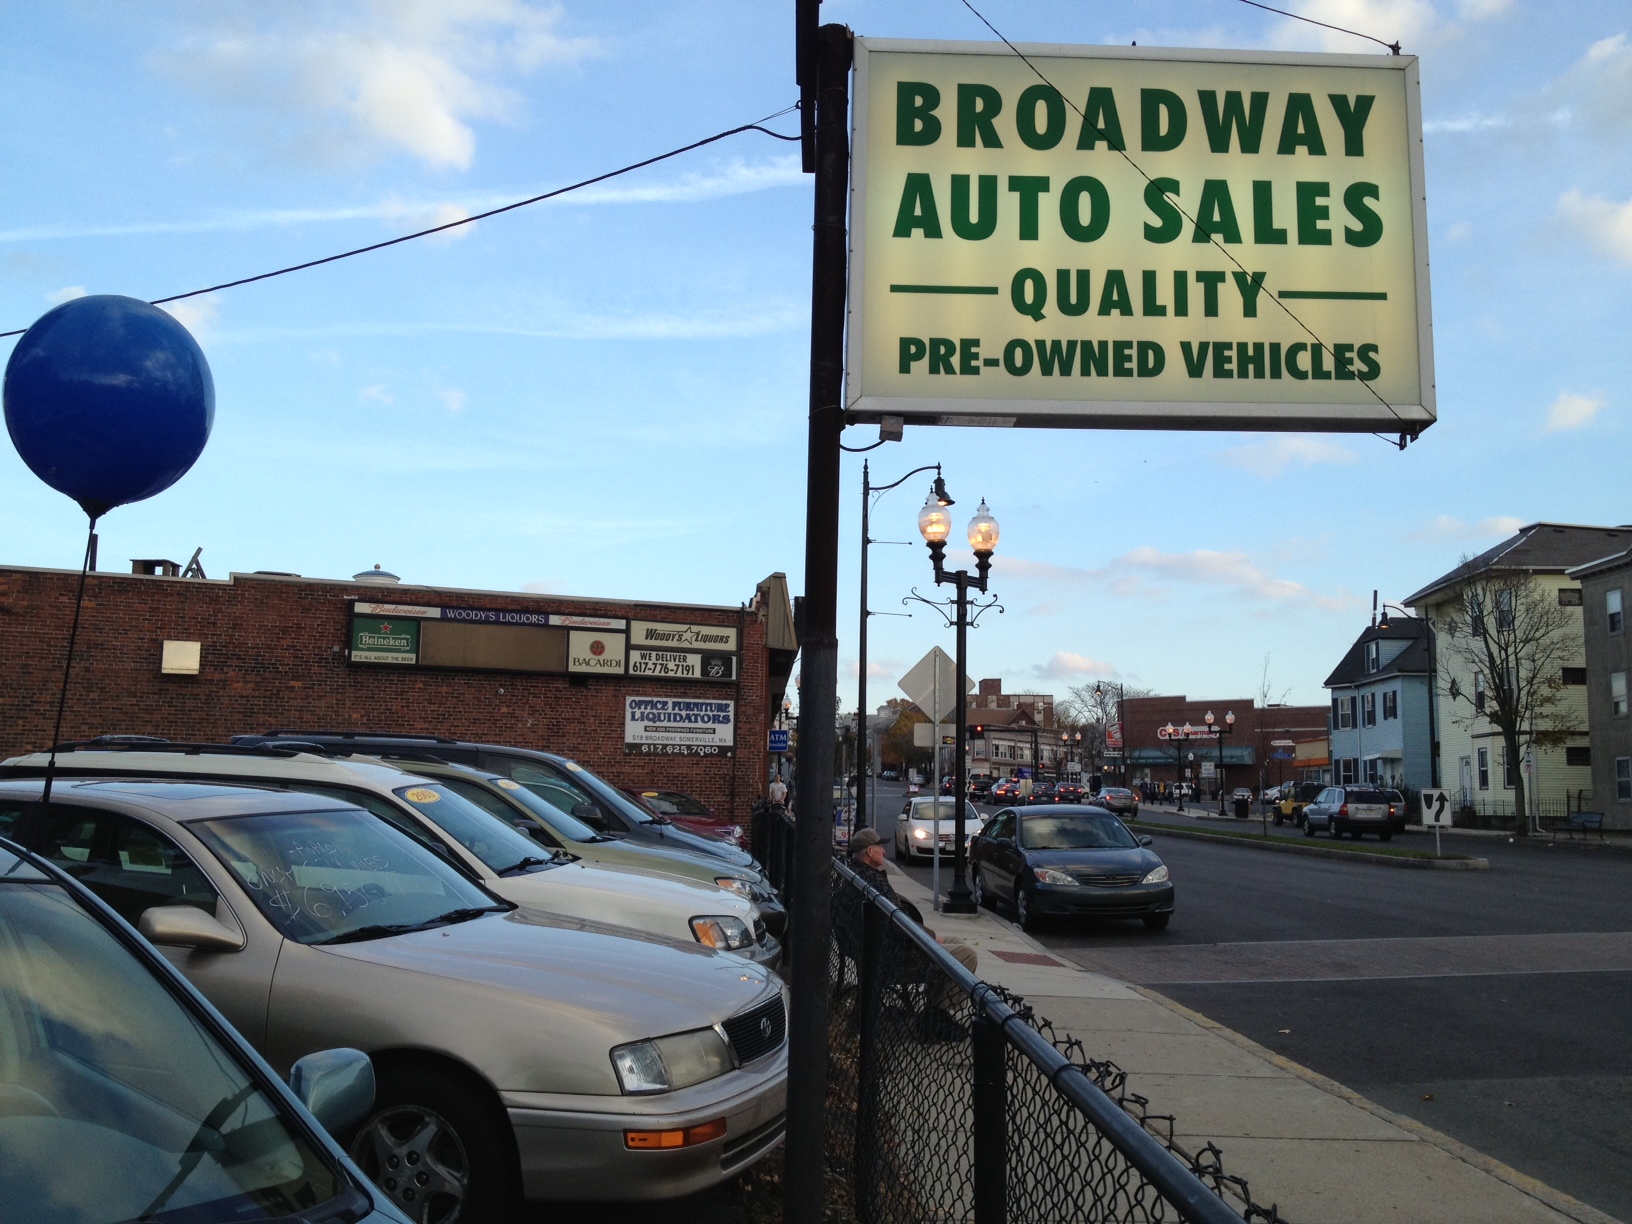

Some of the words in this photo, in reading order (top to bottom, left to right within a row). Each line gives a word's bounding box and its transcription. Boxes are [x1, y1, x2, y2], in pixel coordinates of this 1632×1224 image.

[895, 80, 1376, 157] BROADWAY
[892, 172, 1111, 243] AUTO
[1143, 176, 1384, 247] SALES
[1010, 266, 1268, 322] QUALITY
[898, 336, 1166, 378] PRE-OWNED
[1179, 341, 1382, 381] VEHICLES
[369, 603, 428, 616] Budweiser
[446, 609, 496, 621] WOODY'S
[500, 612, 545, 624] LIQUORS
[559, 615, 612, 627] Budweiser
[361, 635, 407, 647] Heineken
[644, 628, 684, 642] WOODY'S
[694, 630, 731, 644] LIQUORS
[573, 657, 621, 668] BACARDI
[639, 652, 653, 662] WE
[655, 653, 688, 663] DELIVER
[632, 661, 695, 676] 617-776-7191
[629, 699, 669, 711] OFFICE
[671, 701, 731, 713] FURNITURE
[630, 711, 731, 724] LIQUIDATORS
